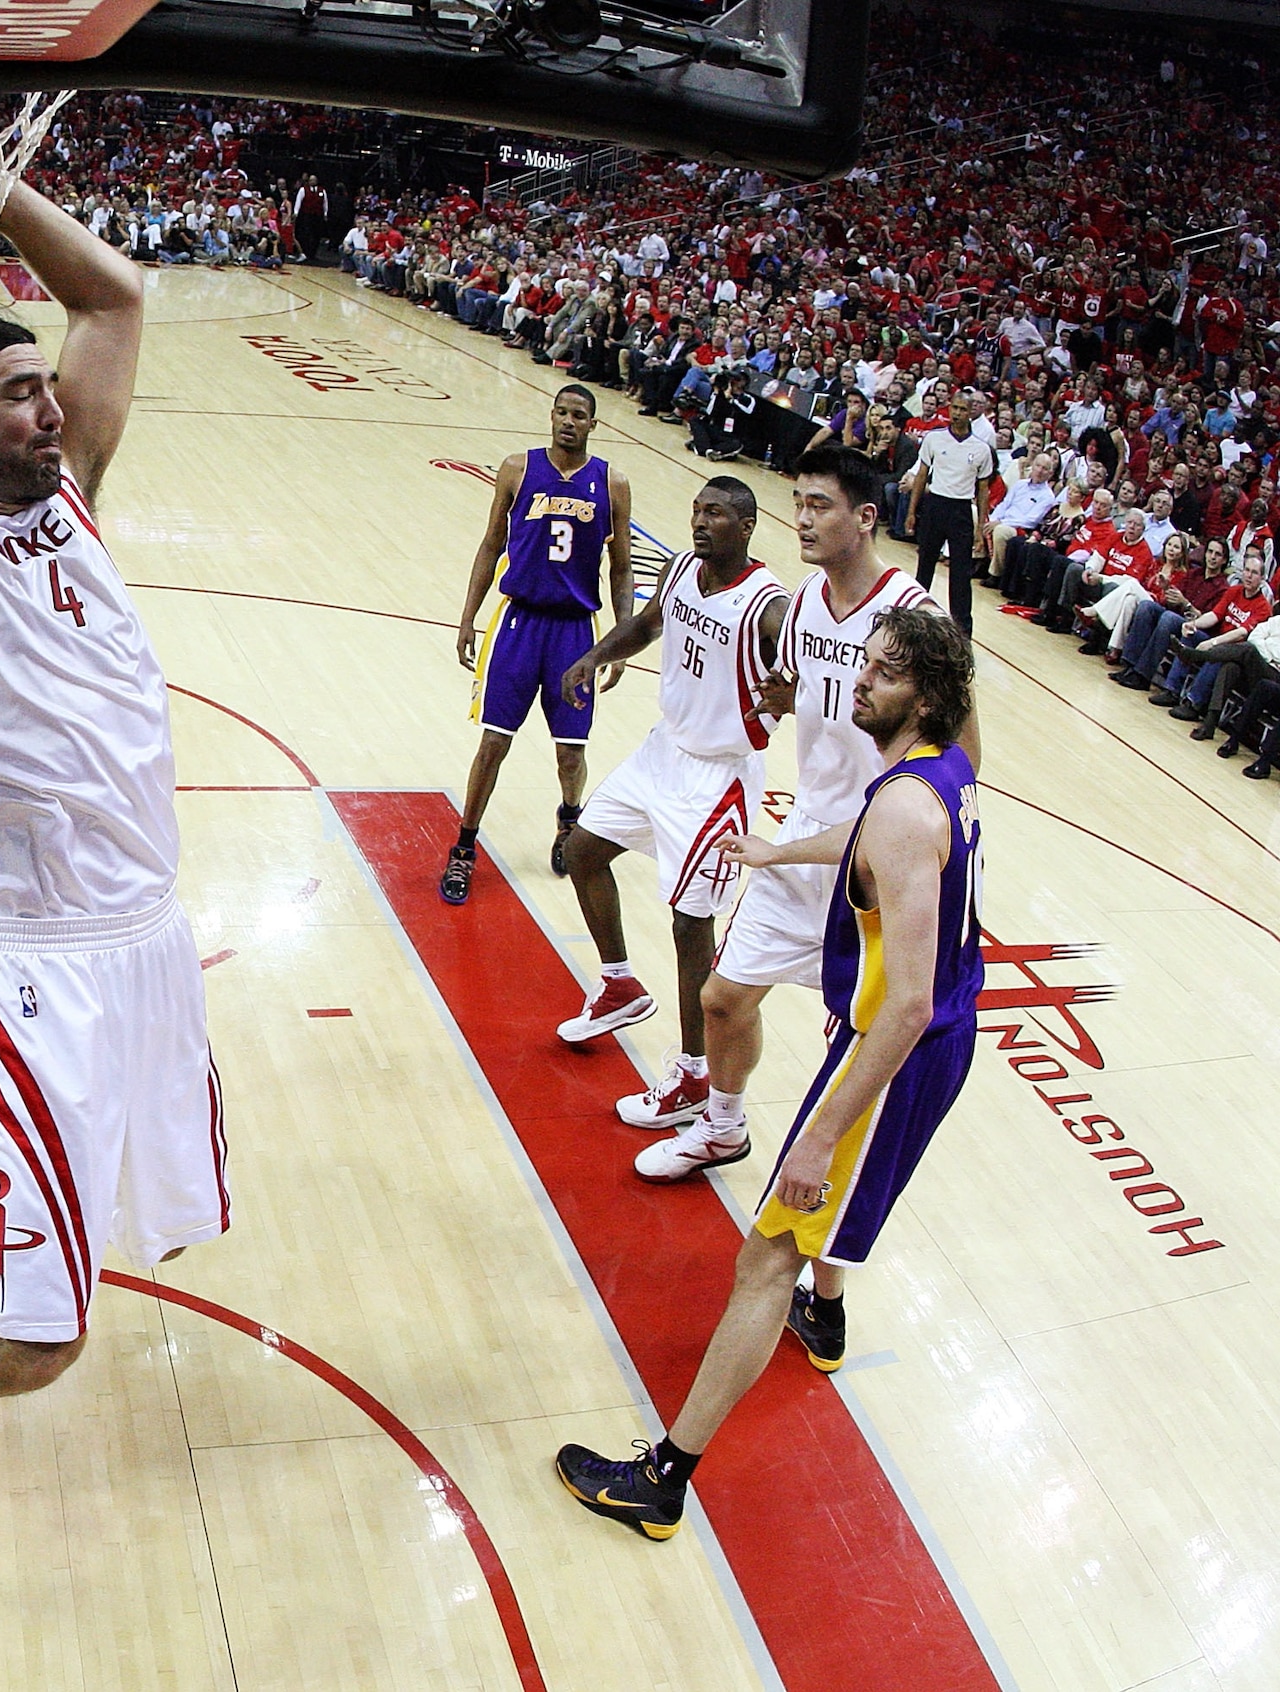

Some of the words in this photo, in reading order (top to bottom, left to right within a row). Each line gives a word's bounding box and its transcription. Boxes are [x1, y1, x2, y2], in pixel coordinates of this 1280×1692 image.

[239, 335, 375, 391] TOYOTA
[311, 338, 452, 400] CENTER
[525, 493, 596, 523] LAKERS
[548, 520, 574, 563] 3
[48, 559, 86, 627] 4
[671, 594, 731, 646] ROCKETS
[681, 635, 707, 680] 96
[823, 677, 841, 721] 11
[976, 1024, 1227, 1257] HOUSTON
